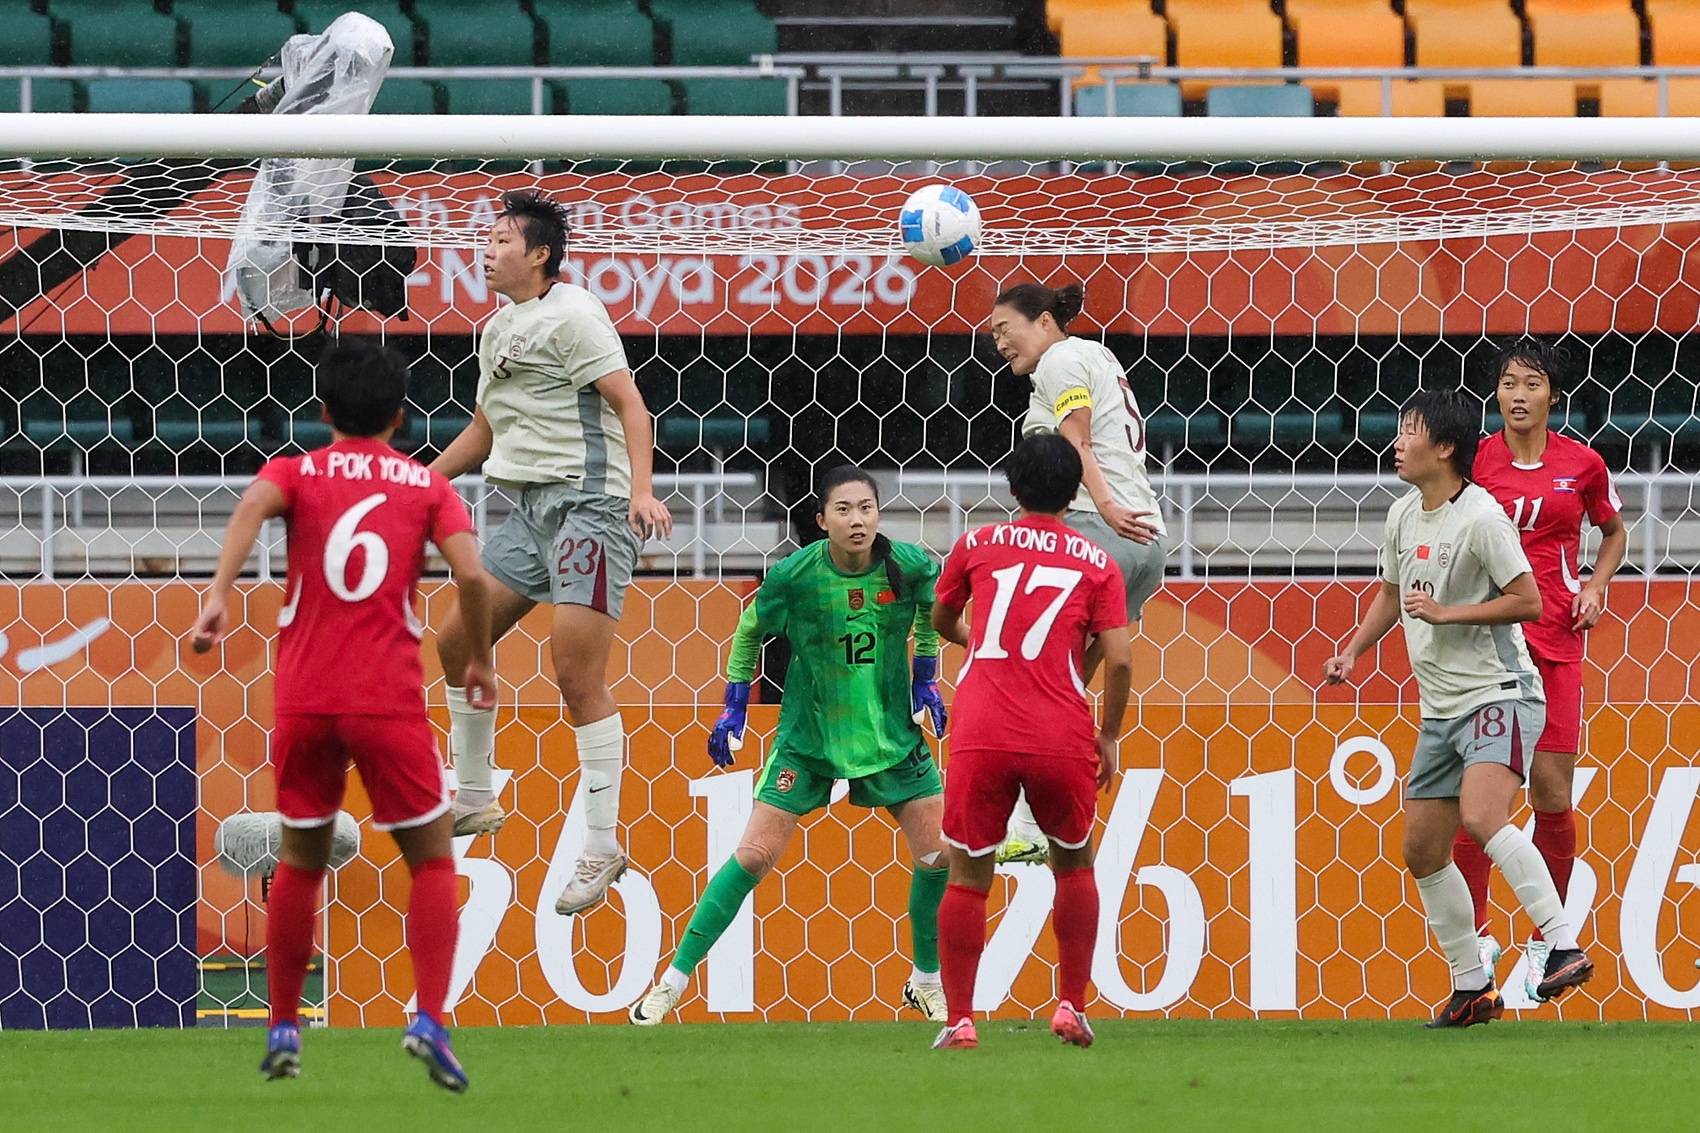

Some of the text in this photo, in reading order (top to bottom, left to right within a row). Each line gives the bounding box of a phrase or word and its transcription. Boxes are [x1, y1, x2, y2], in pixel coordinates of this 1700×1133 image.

[620, 195, 800, 232] Games
[738, 254, 918, 305] 2026
[1056, 393, 1089, 411] Captain
[1117, 375, 1144, 453] 5
[327, 451, 373, 480] POK
[378, 456, 431, 488] YONG
[1513, 495, 1543, 531] 11
[323, 492, 388, 602] 6
[558, 537, 599, 576] 23
[991, 524, 1057, 553] KYONG
[1064, 534, 1108, 570] YONG
[974, 562, 1083, 661] 17
[838, 631, 876, 665] 12
[1469, 705, 1506, 741] 18
